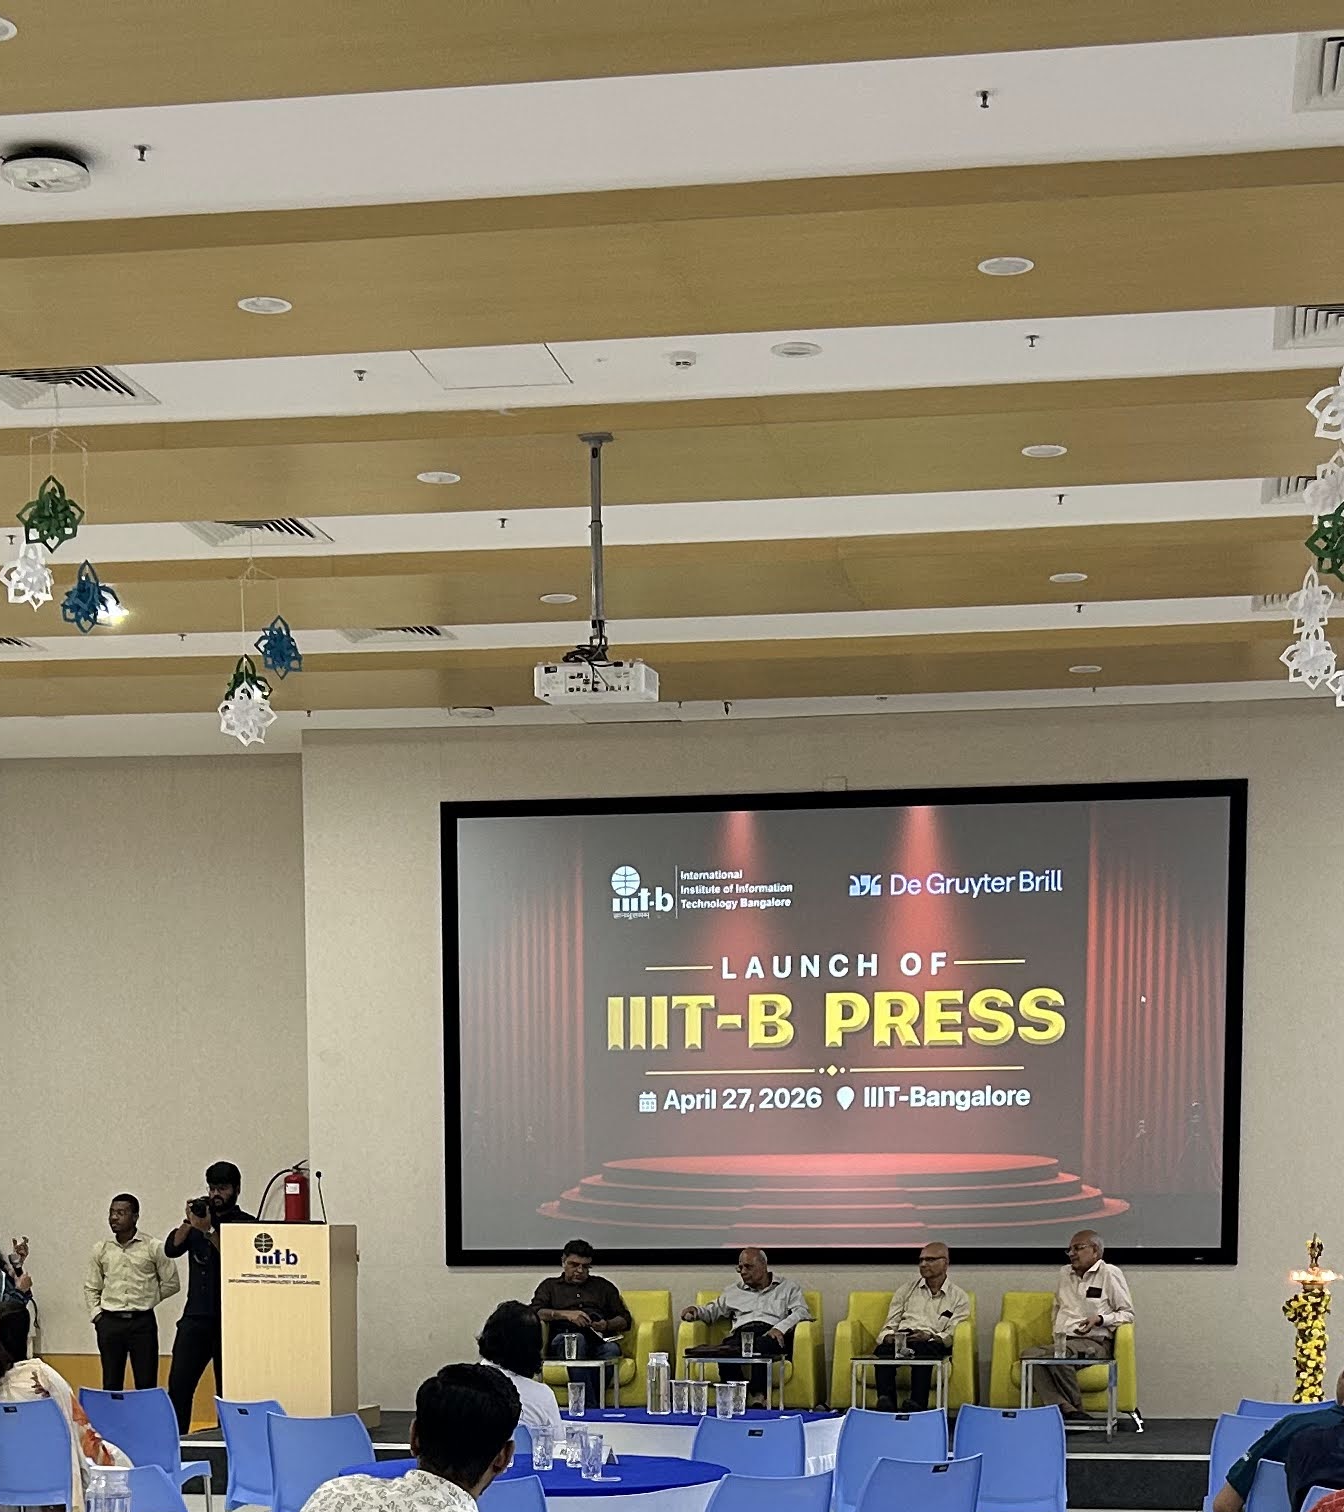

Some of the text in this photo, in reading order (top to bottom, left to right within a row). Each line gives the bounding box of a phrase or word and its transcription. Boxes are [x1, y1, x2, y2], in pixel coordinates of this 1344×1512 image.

[680, 869, 743, 881] International
[680, 883, 793, 895] Institute of Information
[890, 869, 1064, 899] De Gruyter Brill
[680, 897, 792, 911] Technology Bangalore
[722, 951, 948, 980] LAUNCH OF
[607, 987, 1067, 1051] IIIT-B PRESS
[663, 1086, 823, 1114] April 27, 2026
[863, 1084, 1031, 1112] IIIT-Bangalore
